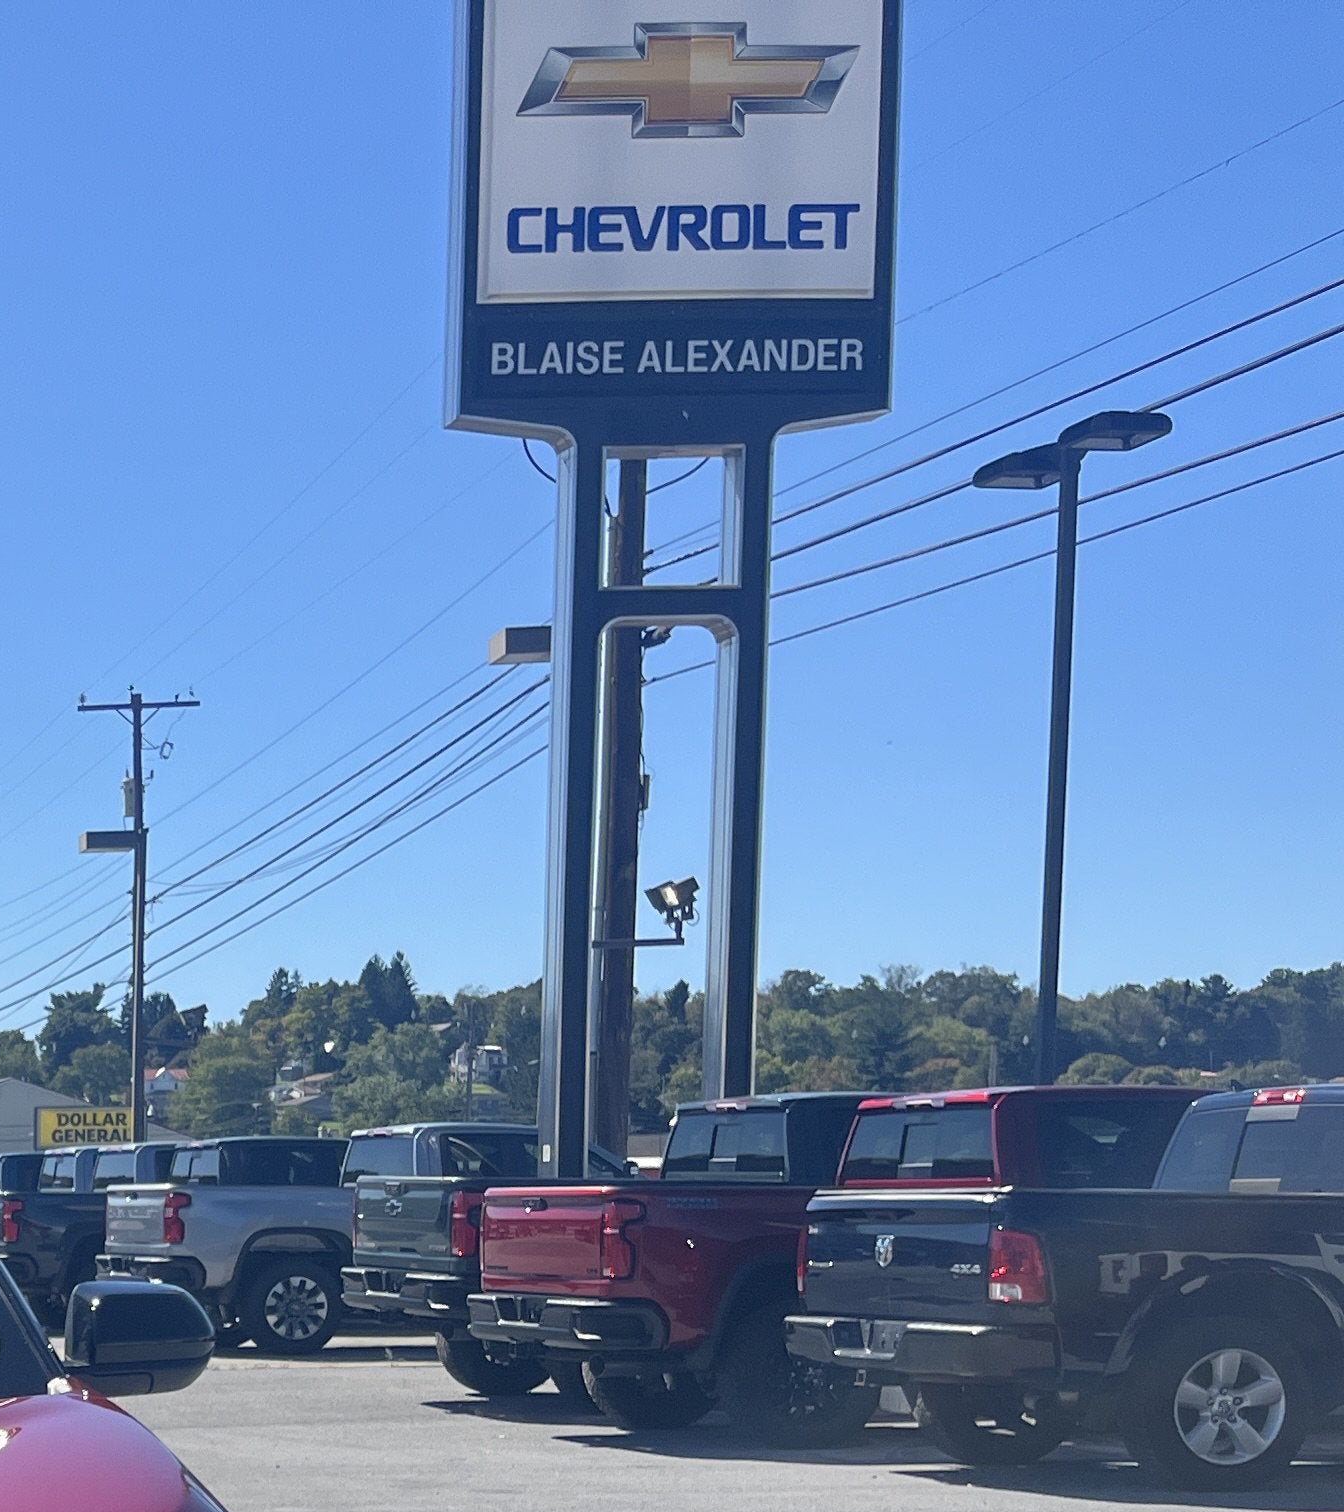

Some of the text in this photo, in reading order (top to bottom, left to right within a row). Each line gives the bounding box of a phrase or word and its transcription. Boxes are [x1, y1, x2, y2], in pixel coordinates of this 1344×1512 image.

[507, 204, 860, 252] CHEVROLET
[491, 338, 864, 375] BLAISE ALEXANDER
[56, 1113, 128, 1126] DOLLAR
[52, 1128, 132, 1143] GENERAL
